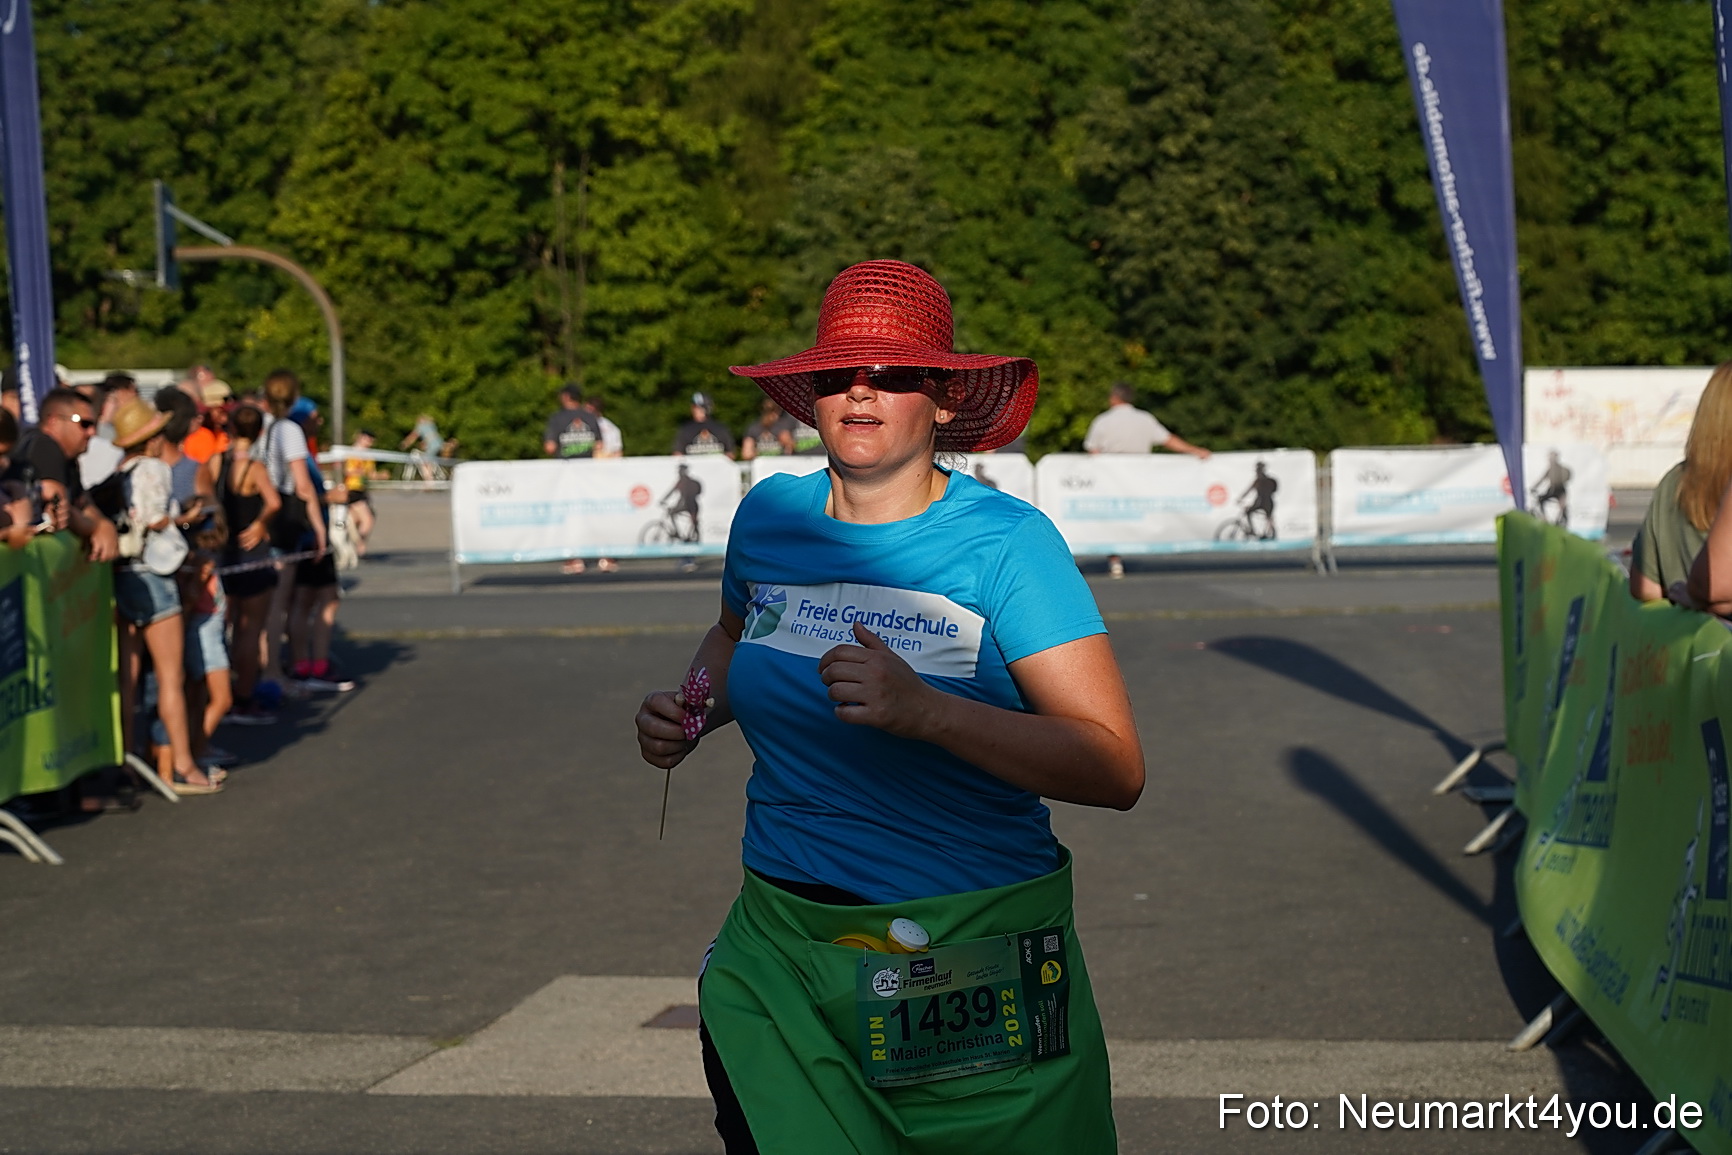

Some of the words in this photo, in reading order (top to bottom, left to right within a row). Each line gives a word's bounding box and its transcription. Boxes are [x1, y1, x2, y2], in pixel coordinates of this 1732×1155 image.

[790, 620, 808, 635] im
[809, 623, 845, 641] Haus
[797, 599, 838, 623] Freie
[841, 604, 960, 639] Grundschule
[1025, 947, 1033, 964] AOK
[903, 969, 953, 989] Firmenlauf
[923, 979, 952, 991] neumarkt
[890, 985, 997, 1042] 1439
[1001, 987, 1024, 1048] 2022
[868, 1016, 887, 1061] RUN
[890, 1045, 933, 1062] Maier
[936, 1032, 1004, 1055] Christina
